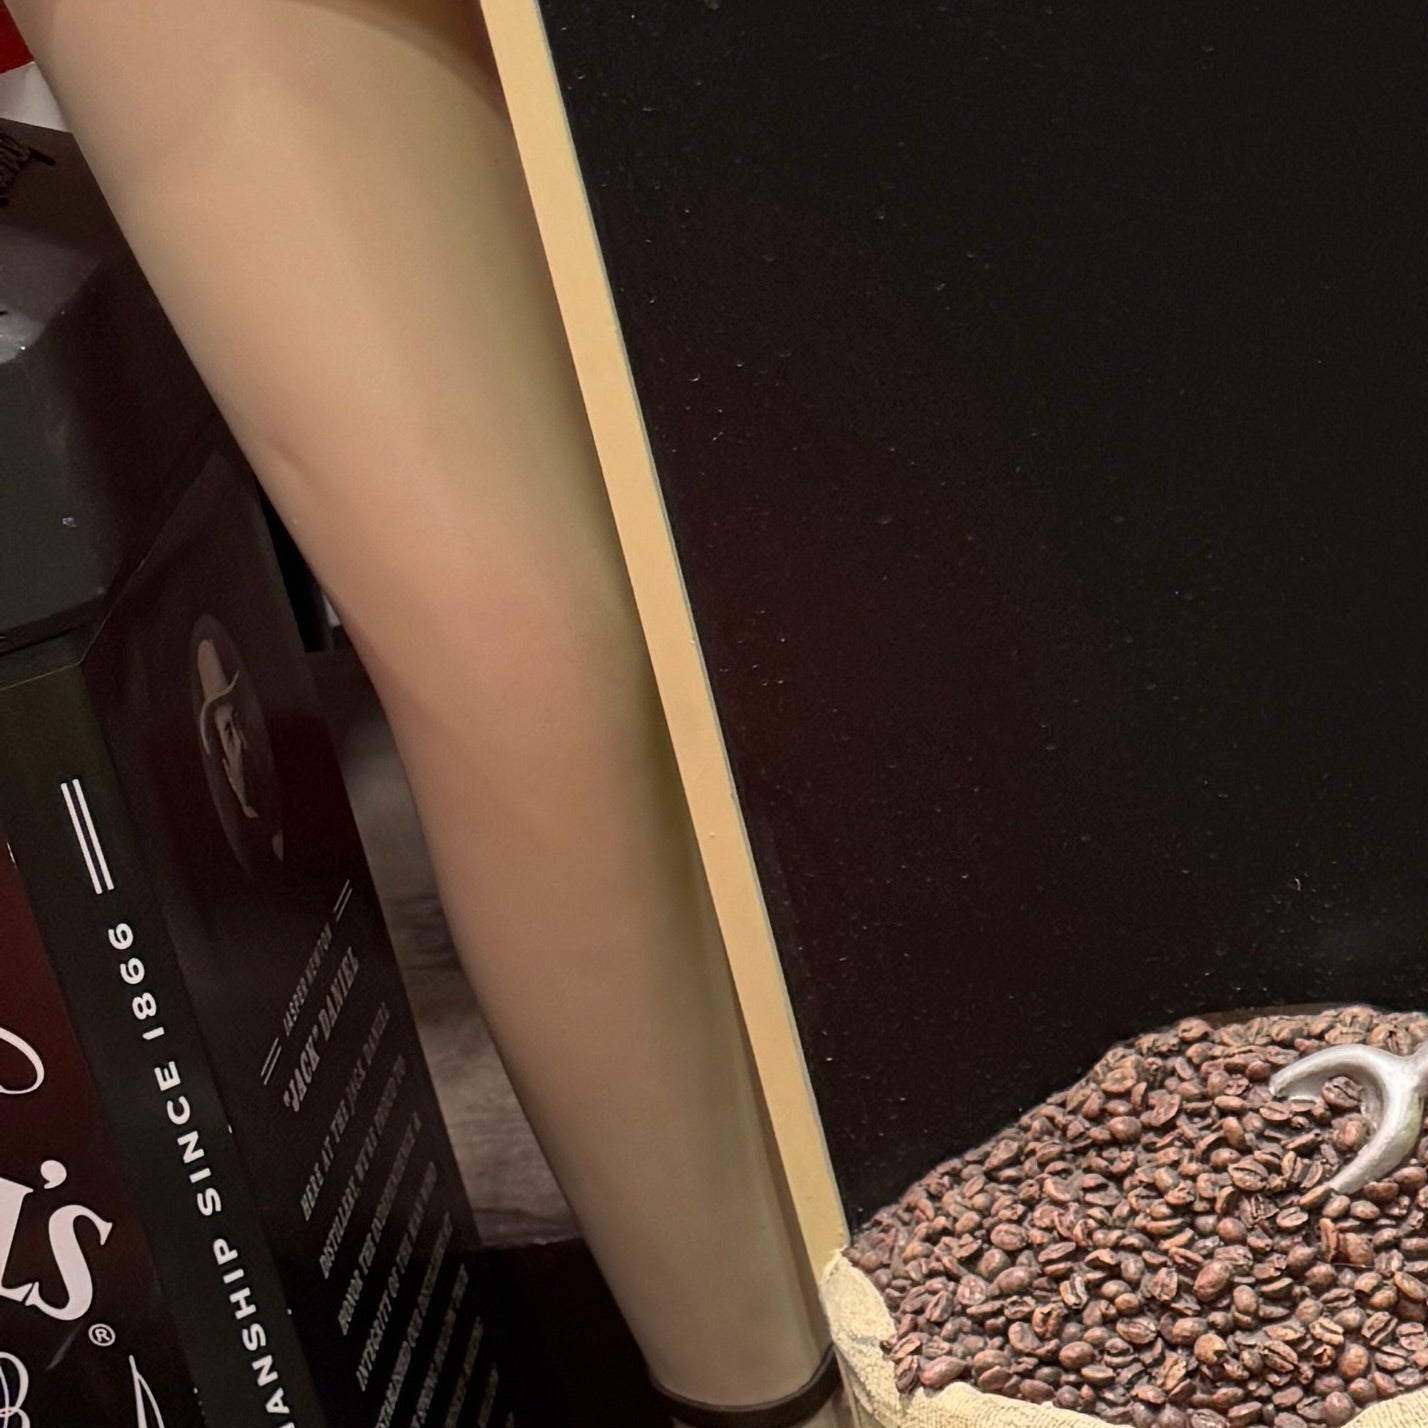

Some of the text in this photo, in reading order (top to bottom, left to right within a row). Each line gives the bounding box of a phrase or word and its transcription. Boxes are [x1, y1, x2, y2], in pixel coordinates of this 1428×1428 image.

[108, 922, 164, 1041] 1866
[282, 922, 333, 1037] JASPER NEWTON
[282, 946, 359, 1113] "JACK" DANIEL
[153, 1060, 222, 1216] SINCE
[300, 1162, 324, 1222] HERE
[320, 1135, 334, 1173] AT
[329, 1098, 350, 1144] THE
[345, 1057, 367, 1117] JACK
[318, 1175, 361, 1280] DISTILLERY,
[337, 1269, 364, 1336] HONOR
[357, 1232, 377, 1276] THE
[355, 1289, 393, 1392] INTEGRITY
[387, 1265, 401, 1299] OF
[395, 1232, 413, 1275] THE
